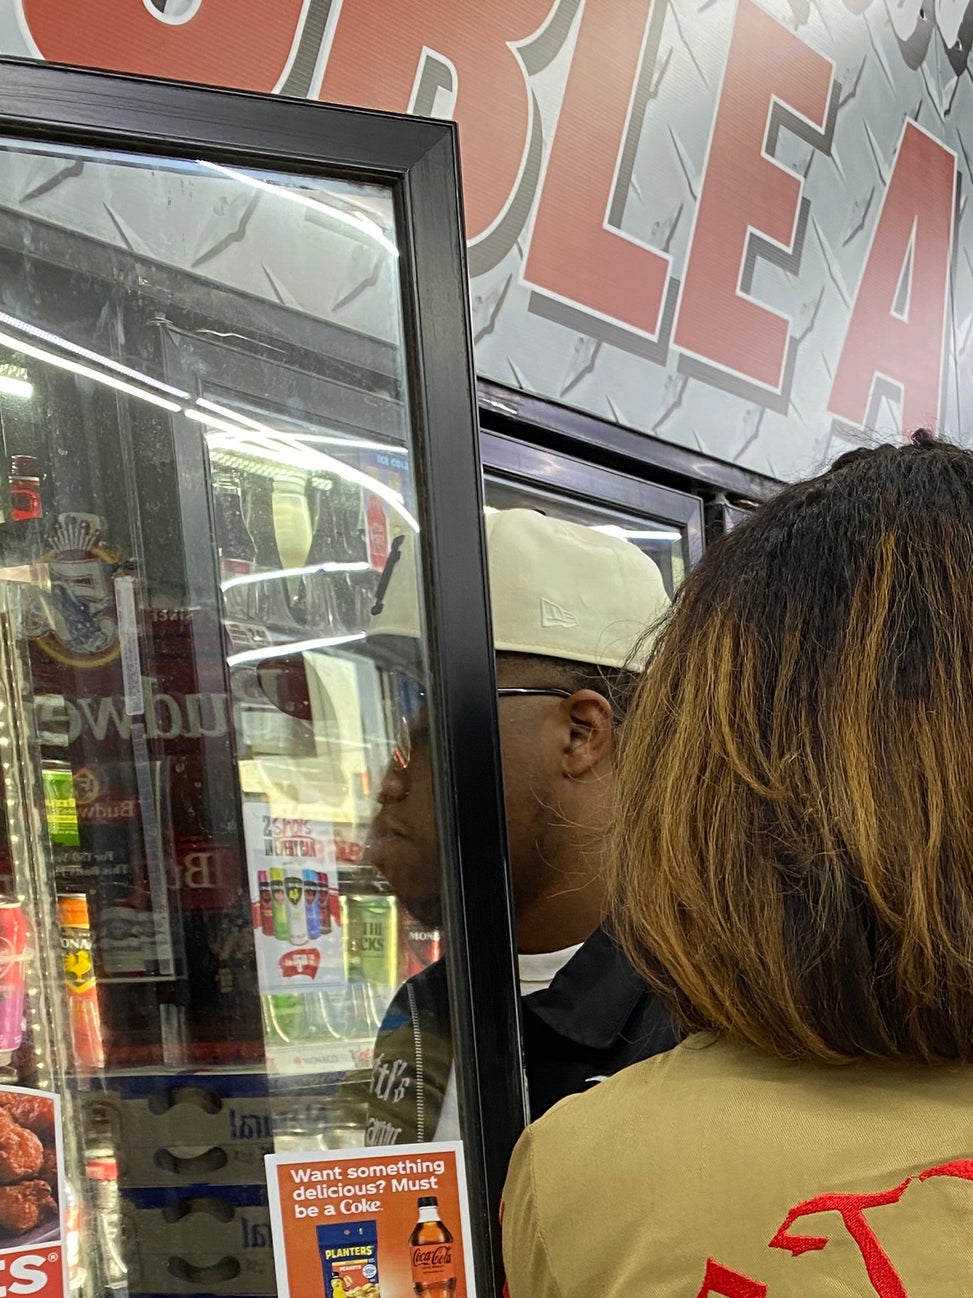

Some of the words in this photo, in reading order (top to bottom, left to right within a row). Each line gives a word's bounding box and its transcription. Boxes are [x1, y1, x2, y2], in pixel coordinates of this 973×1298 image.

[826, 117, 958, 438] A
[290, 1166, 343, 1185] Want
[347, 1158, 445, 1180] something
[292, 1179, 386, 1201] delicious?
[391, 1174, 439, 1193] Must
[294, 1203, 319, 1219] be
[323, 1206, 336, 1217] a
[340, 1199, 384, 1214] Coke
[325, 1245, 374, 1260] PLANTERS
